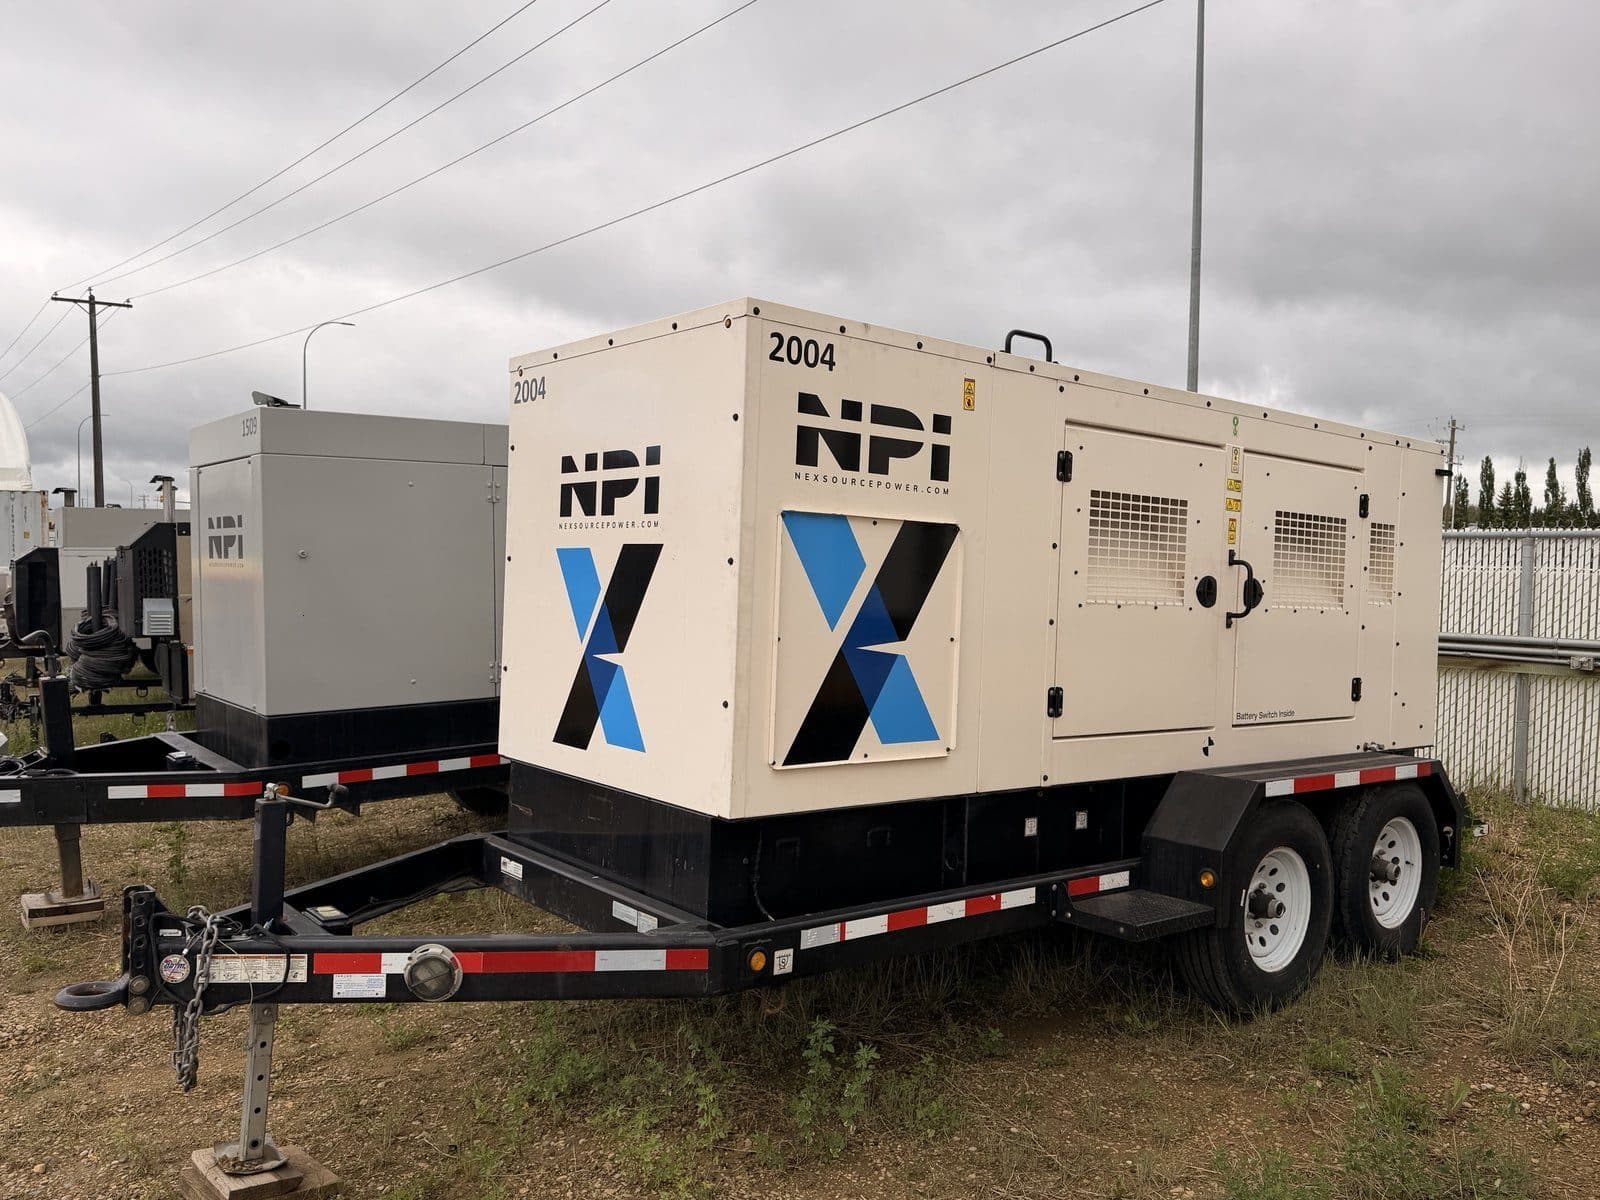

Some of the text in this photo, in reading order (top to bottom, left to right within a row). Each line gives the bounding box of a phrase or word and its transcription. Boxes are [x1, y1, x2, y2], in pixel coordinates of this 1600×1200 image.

[768, 331, 837, 372] 2004
[513, 376, 546, 404] 2004
[242, 416, 258, 437] 1509
[794, 472, 950, 495] NEXSOURCEPOWER.COM
[558, 520, 660, 530] NEXSOURCEPOWER.COM
[1236, 709, 1296, 721] Battery Switch Inside
